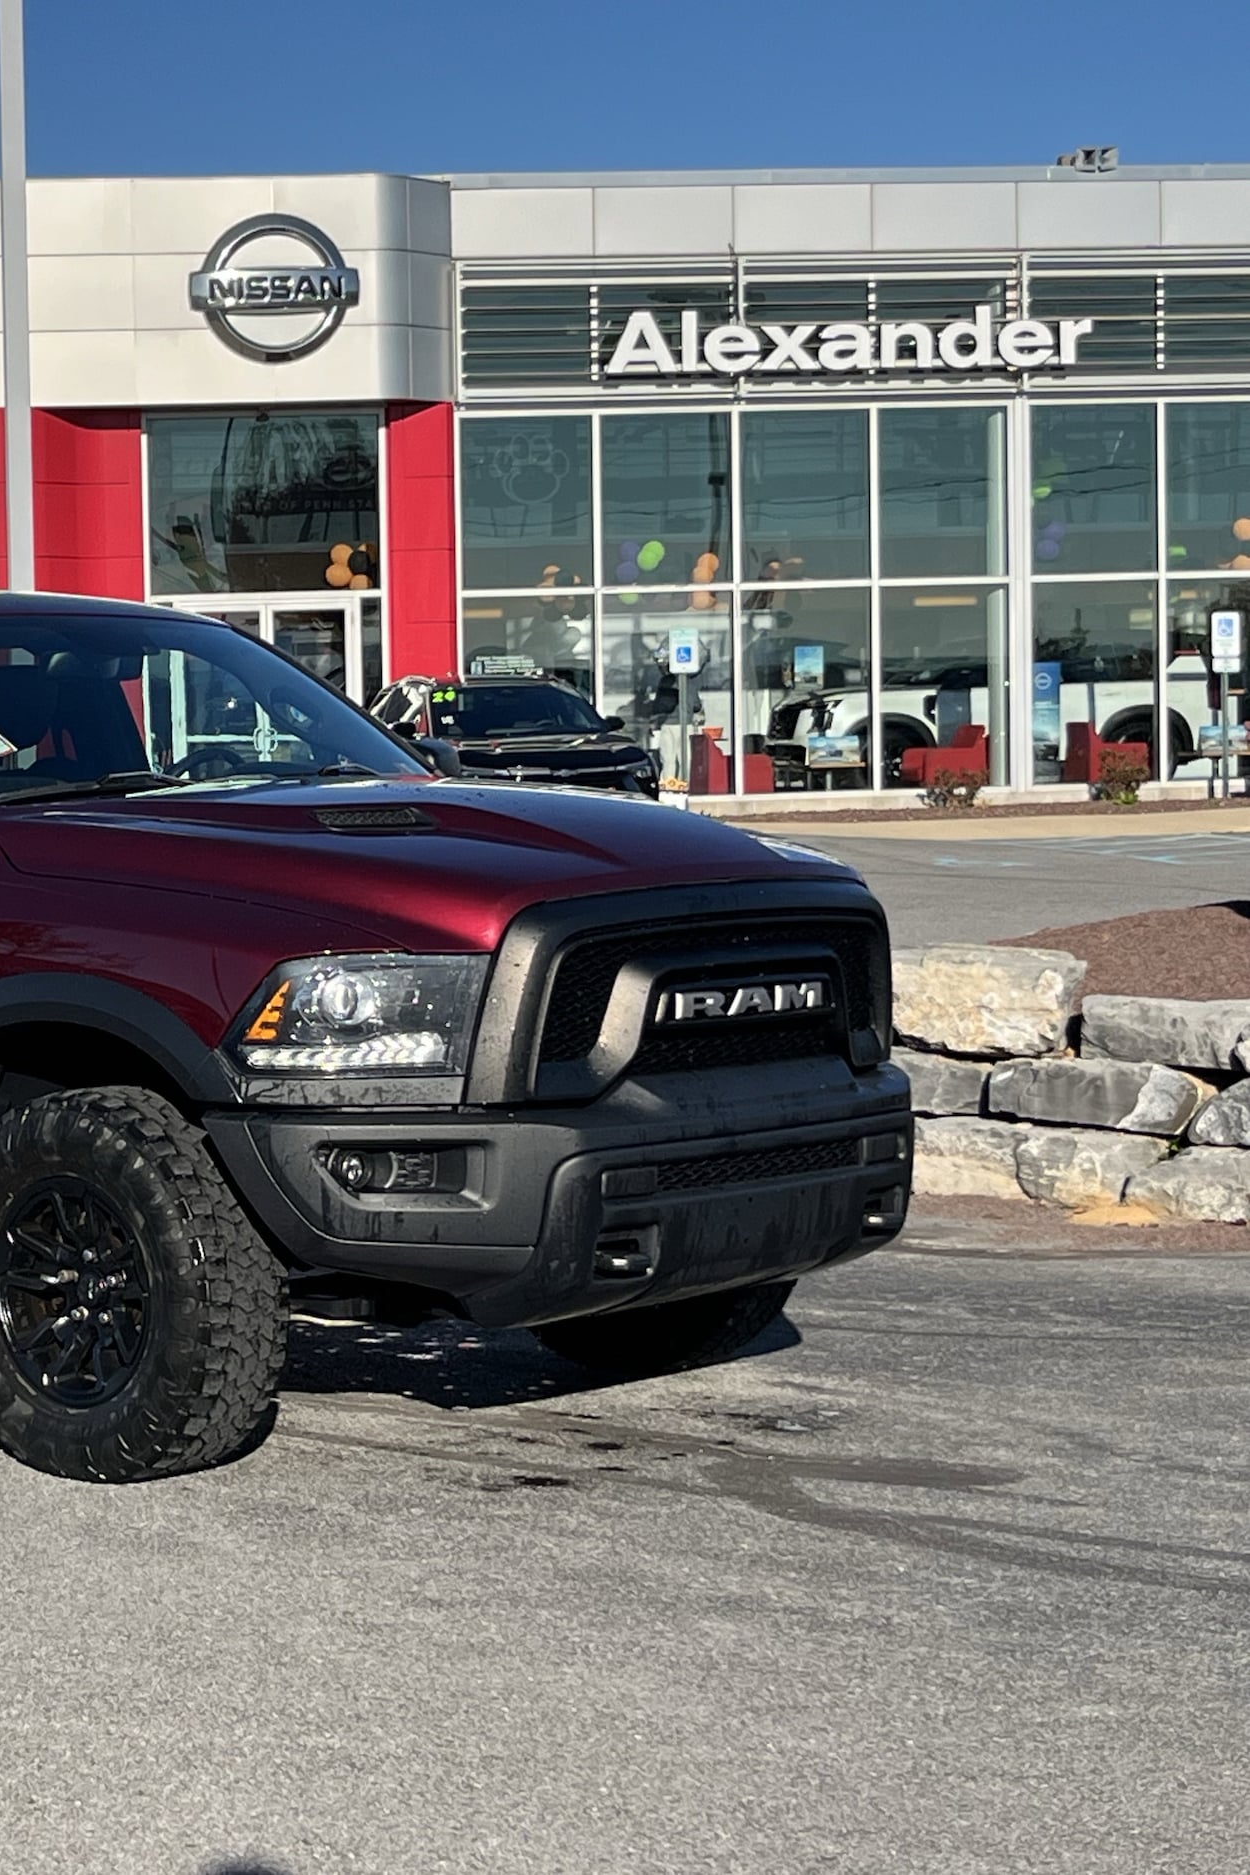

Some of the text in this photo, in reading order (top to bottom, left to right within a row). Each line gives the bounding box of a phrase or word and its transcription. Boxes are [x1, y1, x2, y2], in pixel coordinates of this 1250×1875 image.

[207, 275, 345, 304] NISSAN
[605, 305, 1092, 374] Alexander
[673, 981, 823, 1020] RAM
